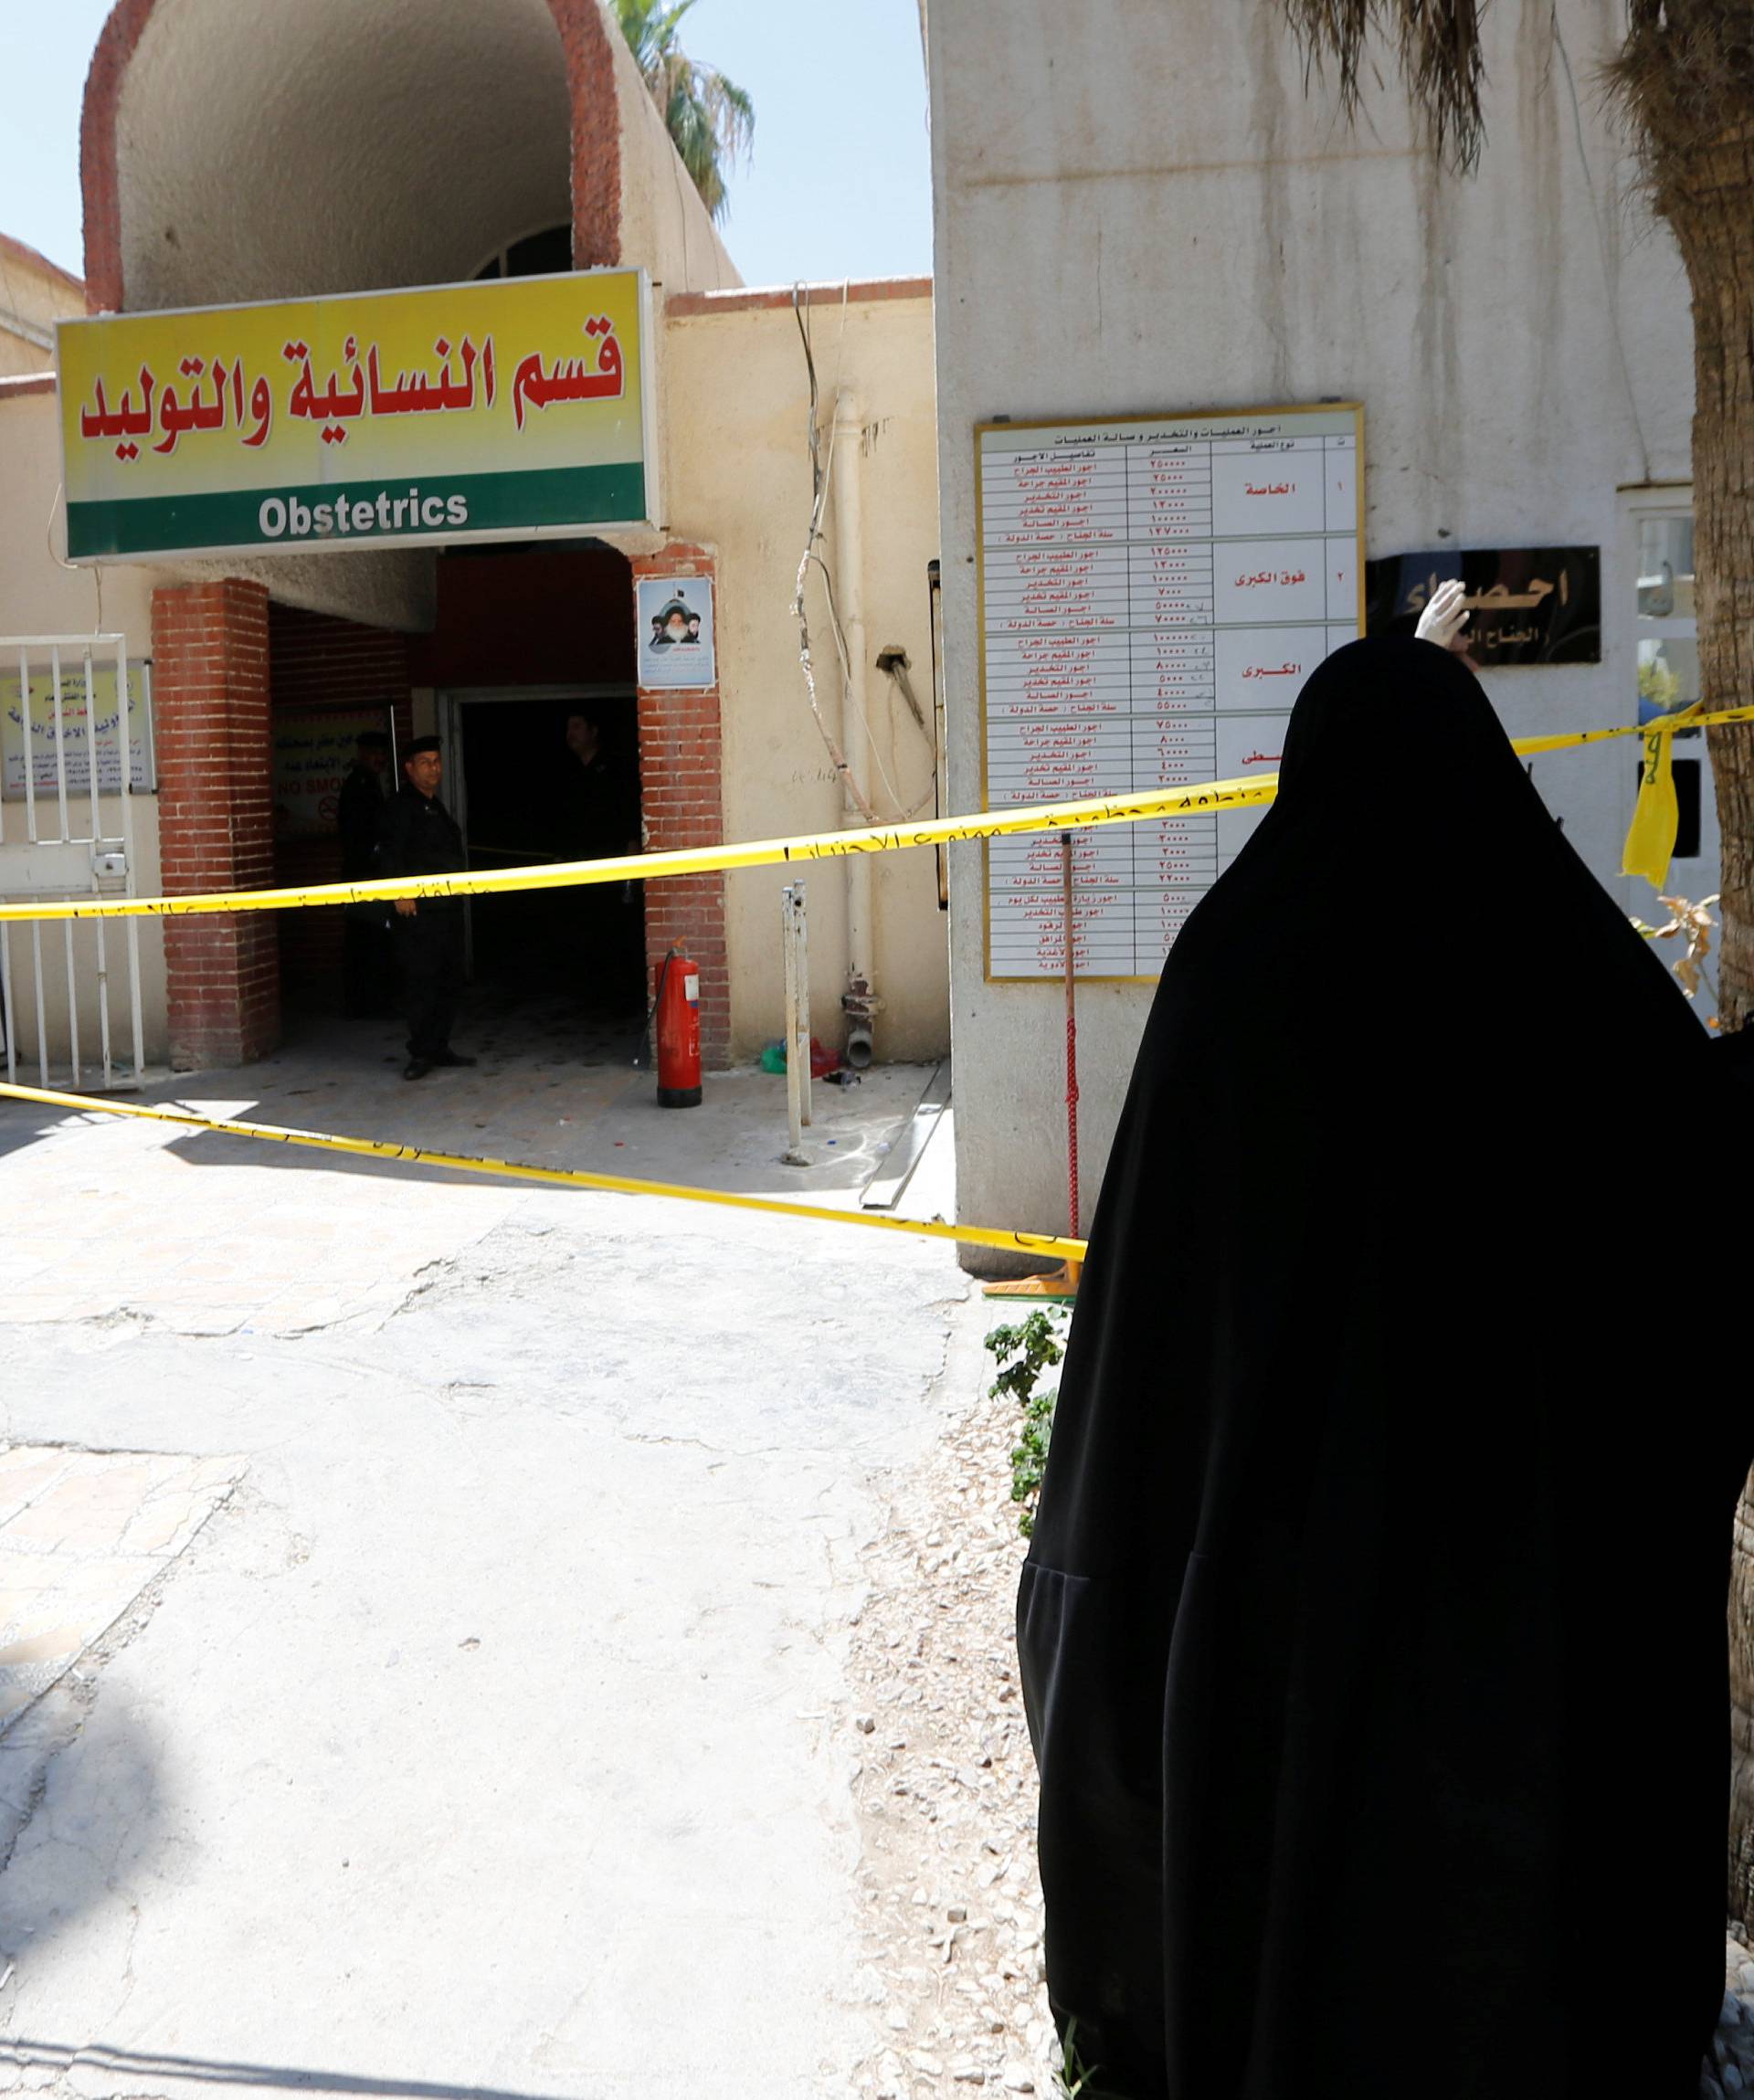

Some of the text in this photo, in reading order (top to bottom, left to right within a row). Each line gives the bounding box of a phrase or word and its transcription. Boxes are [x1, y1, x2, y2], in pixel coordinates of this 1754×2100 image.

[81, 316, 623, 461] قسم النسائية والتوليد
[259, 489, 468, 536] Obstetrics
[278, 780, 301, 797] NO
